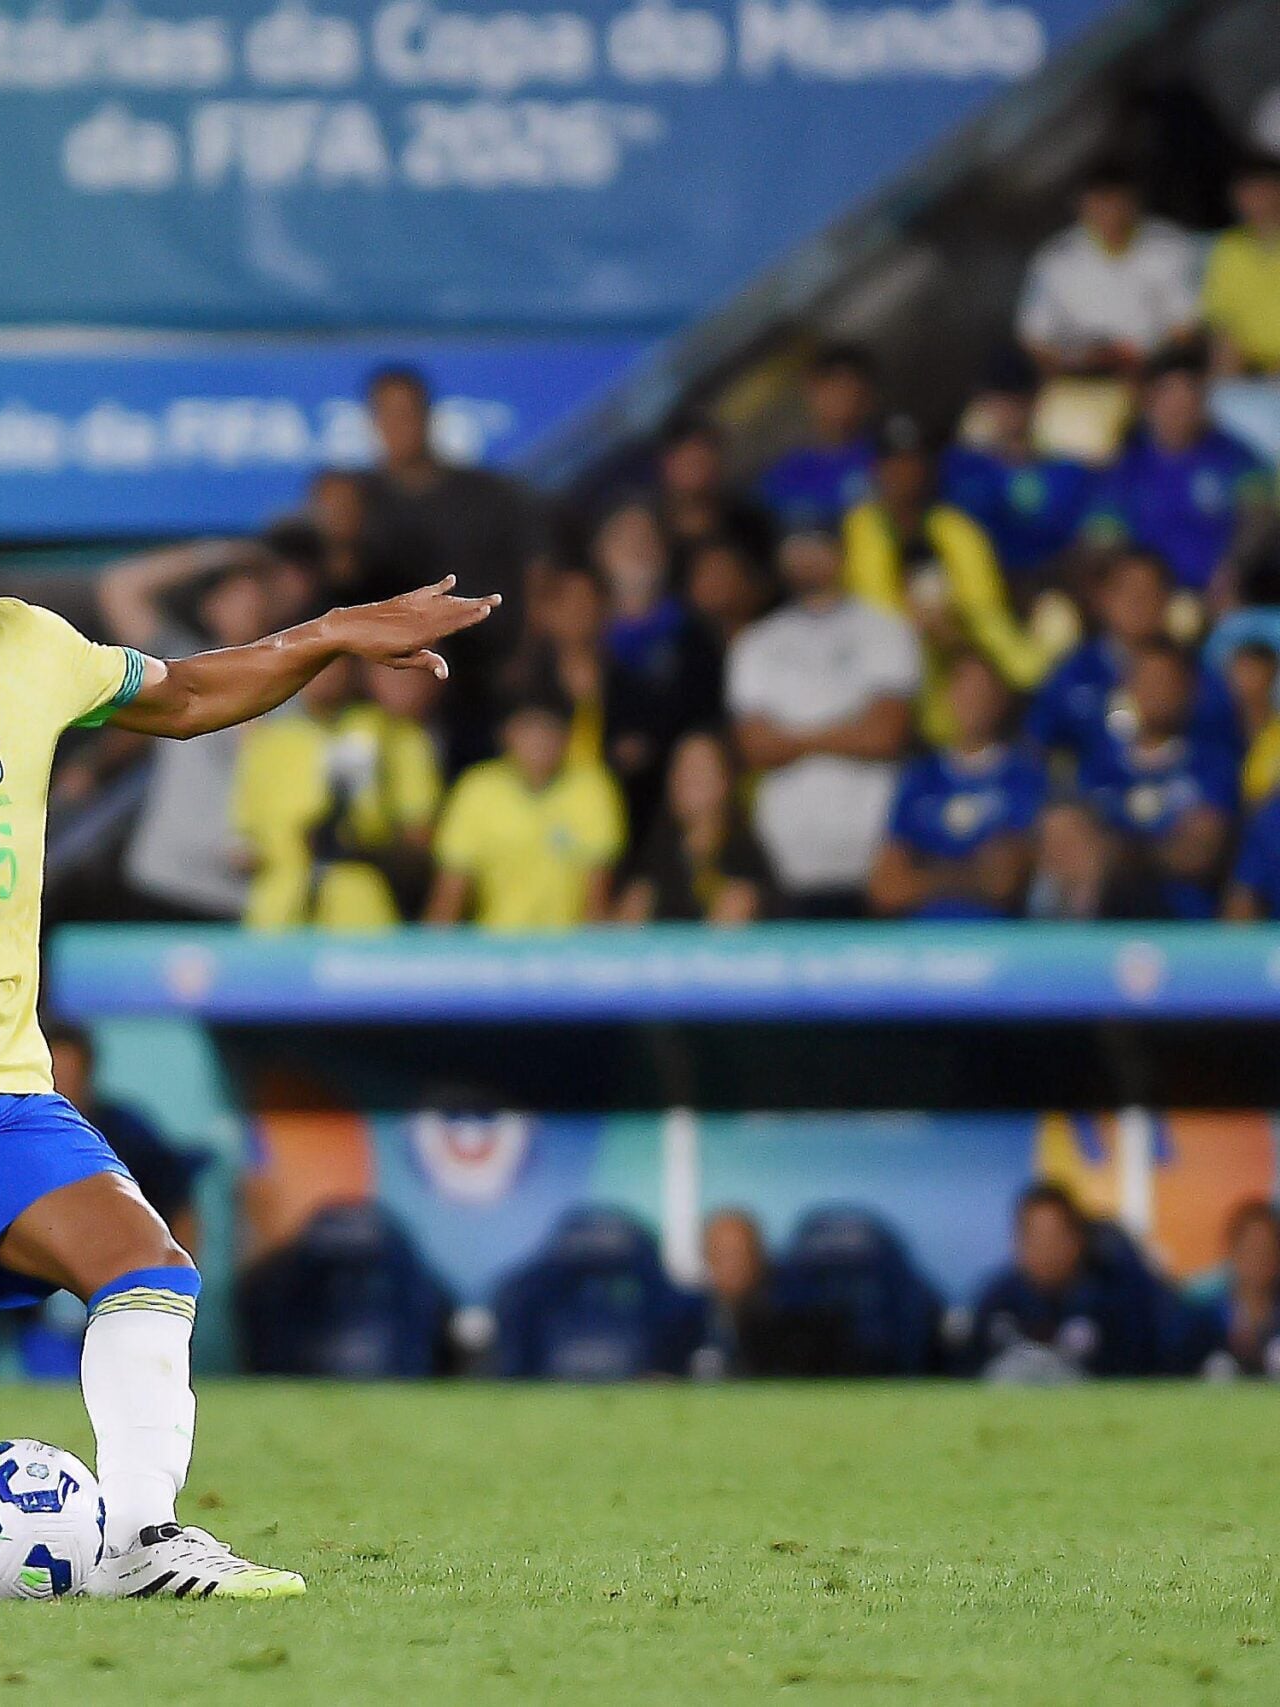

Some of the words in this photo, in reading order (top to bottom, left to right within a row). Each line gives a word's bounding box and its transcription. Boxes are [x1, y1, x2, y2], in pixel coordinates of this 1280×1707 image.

[245, 0, 360, 86] da
[375, 3, 595, 95] Copa
[608, 0, 723, 82] do
[736, 0, 1045, 80] Mundo
[64, 105, 177, 190] da
[192, 103, 388, 187] FIFA
[167, 397, 310, 468] FIFA
